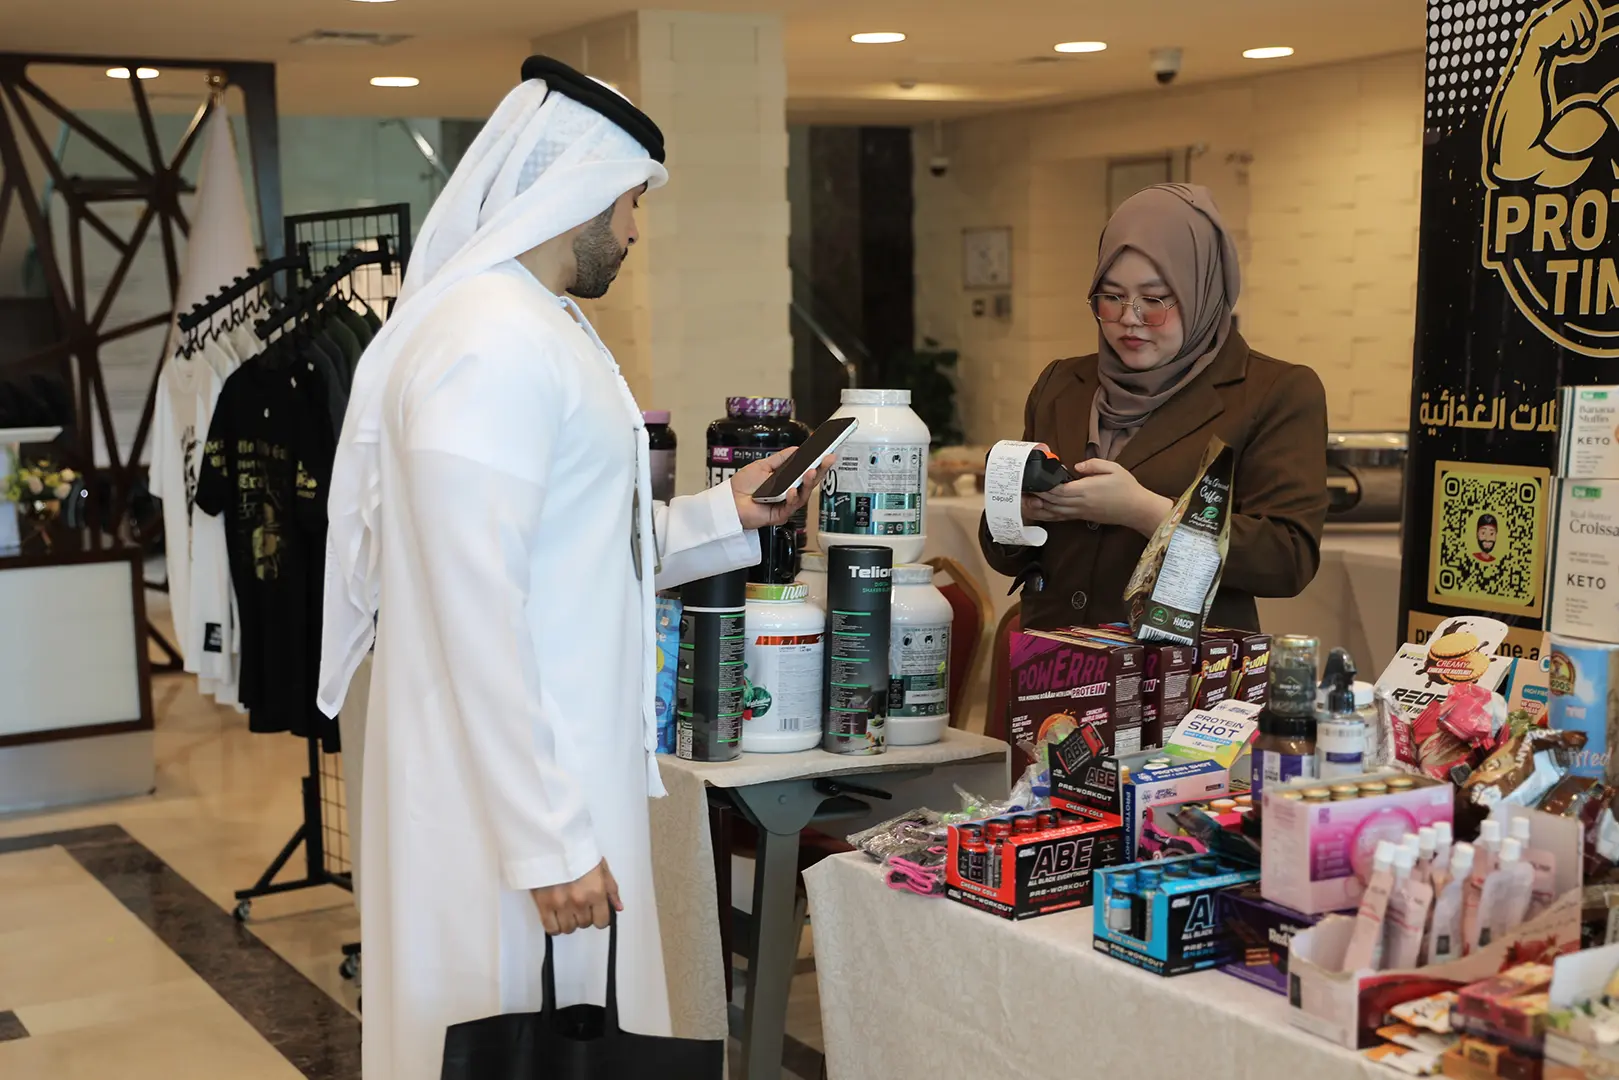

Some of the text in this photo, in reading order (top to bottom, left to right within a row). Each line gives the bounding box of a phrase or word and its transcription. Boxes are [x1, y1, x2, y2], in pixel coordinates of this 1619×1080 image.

[1495, 189, 1619, 253] PRO
[1420, 389, 1506, 436] الغذائية
[1577, 437, 1610, 446] KETO
[1567, 573, 1606, 590] KETO
[1173, 616, 1194, 630] HACCP
[1209, 655, 1231, 673] LION
[1250, 651, 1270, 669] LION
[1436, 659, 1469, 669] CREAMY
[1018, 648, 1108, 693] POWERRR
[1072, 683, 1106, 696] PROTEIN
[1188, 721, 1240, 738] SHOT
[1194, 714, 1244, 729] PROTEIN
[1086, 766, 1116, 788] ABE
[1058, 782, 1112, 801] PRE-WORKOUT
[1065, 803, 1103, 818] CHERRY COLA
[1030, 837, 1094, 880] ABE
[961, 881, 997, 897] CHERRY COLA
[1028, 879, 1037, 887] ALL
[1038, 876, 1056, 885] BLACK
[1029, 880, 1090, 897] PRE-WORKOUT
[962, 891, 1013, 912] PRE-WORKOUT
[1194, 928, 1213, 939] BLACK
[1110, 943, 1164, 967] PRE-WORKOUT
